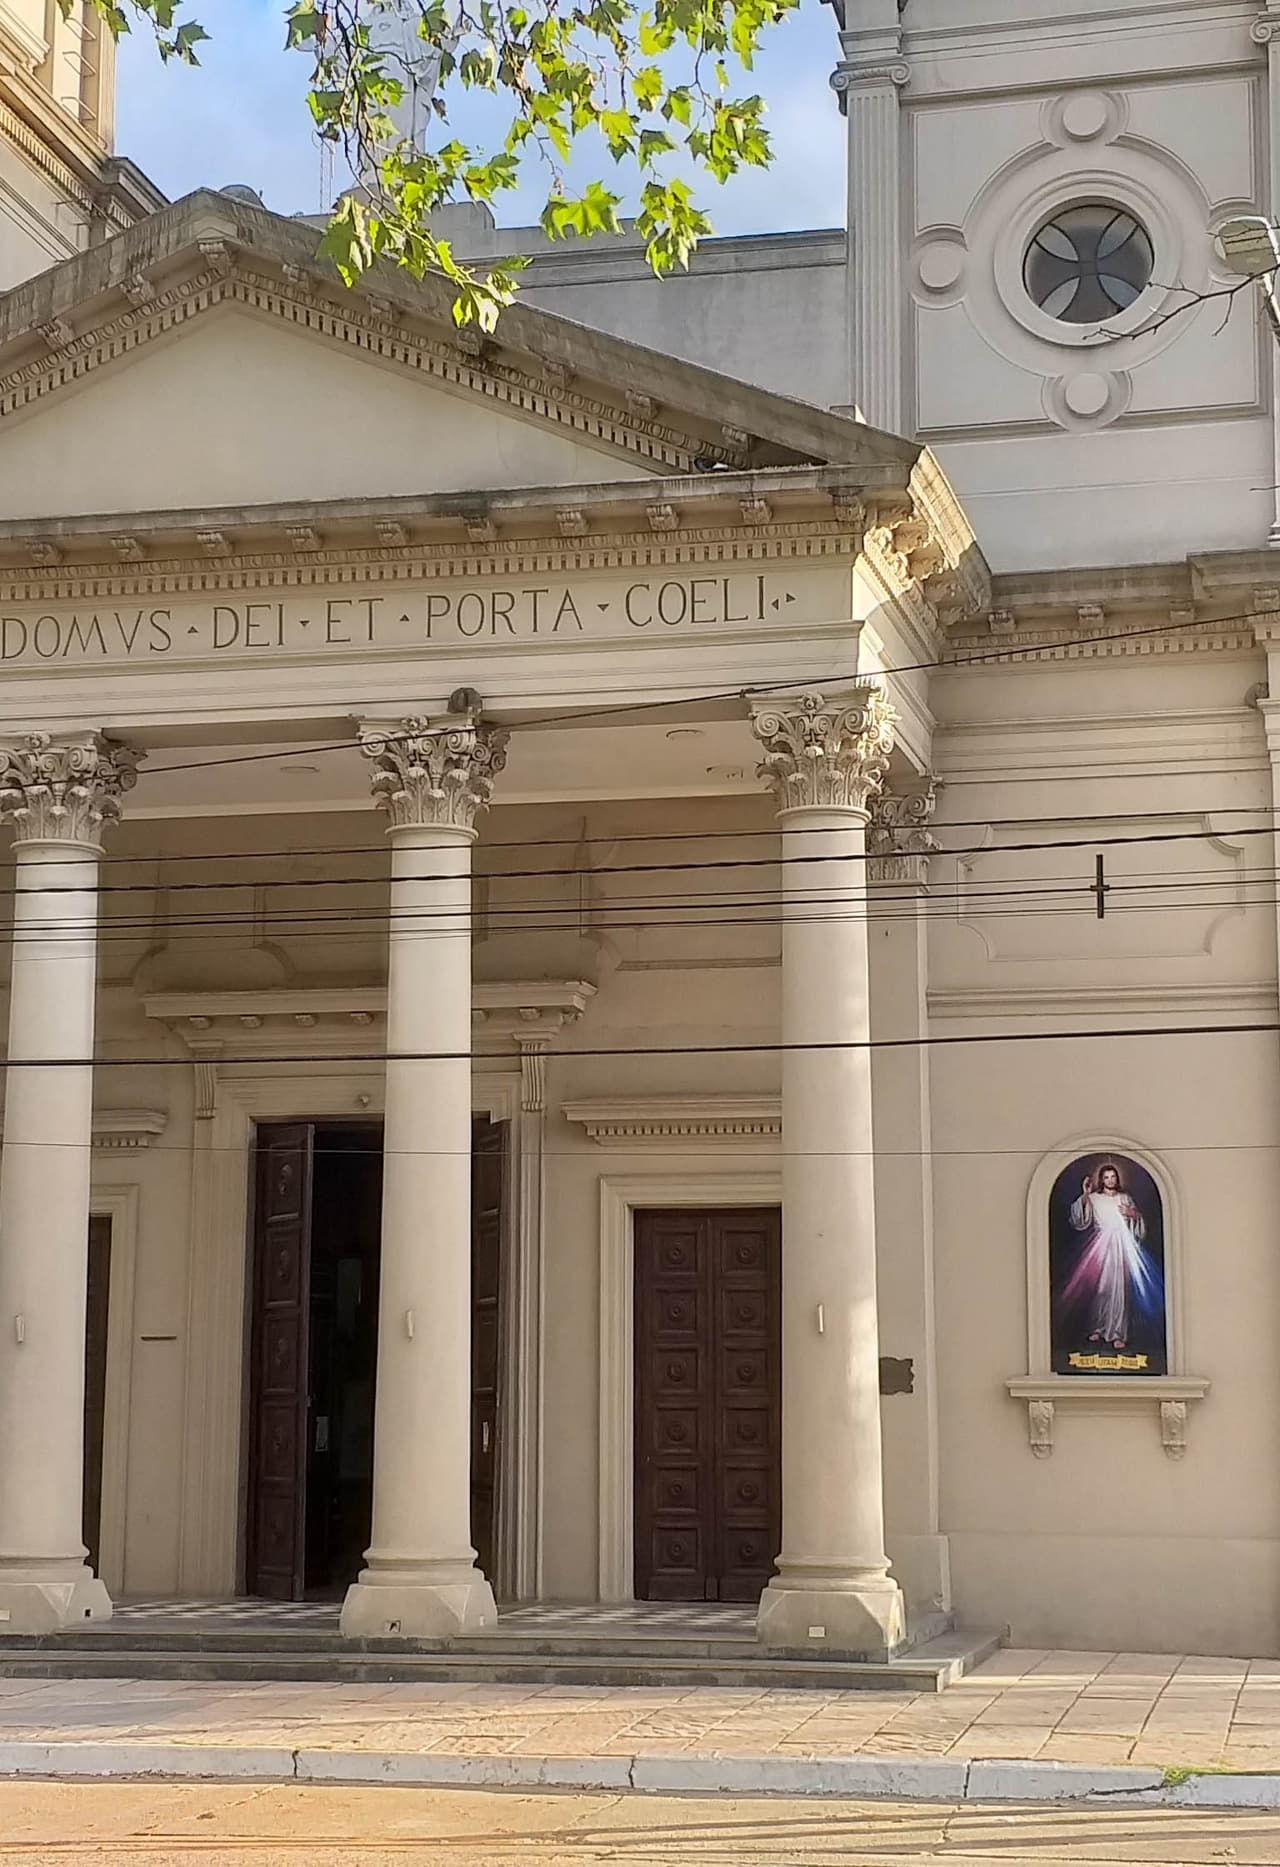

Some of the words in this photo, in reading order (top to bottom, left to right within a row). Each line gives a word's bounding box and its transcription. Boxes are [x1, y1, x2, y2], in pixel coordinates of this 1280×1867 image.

[1, 609, 172, 660] DOMVS
[212, 603, 286, 649] DEI
[325, 598, 384, 643] ET
[425, 588, 584, 638] PORTA
[625, 575, 766, 627] COELI
